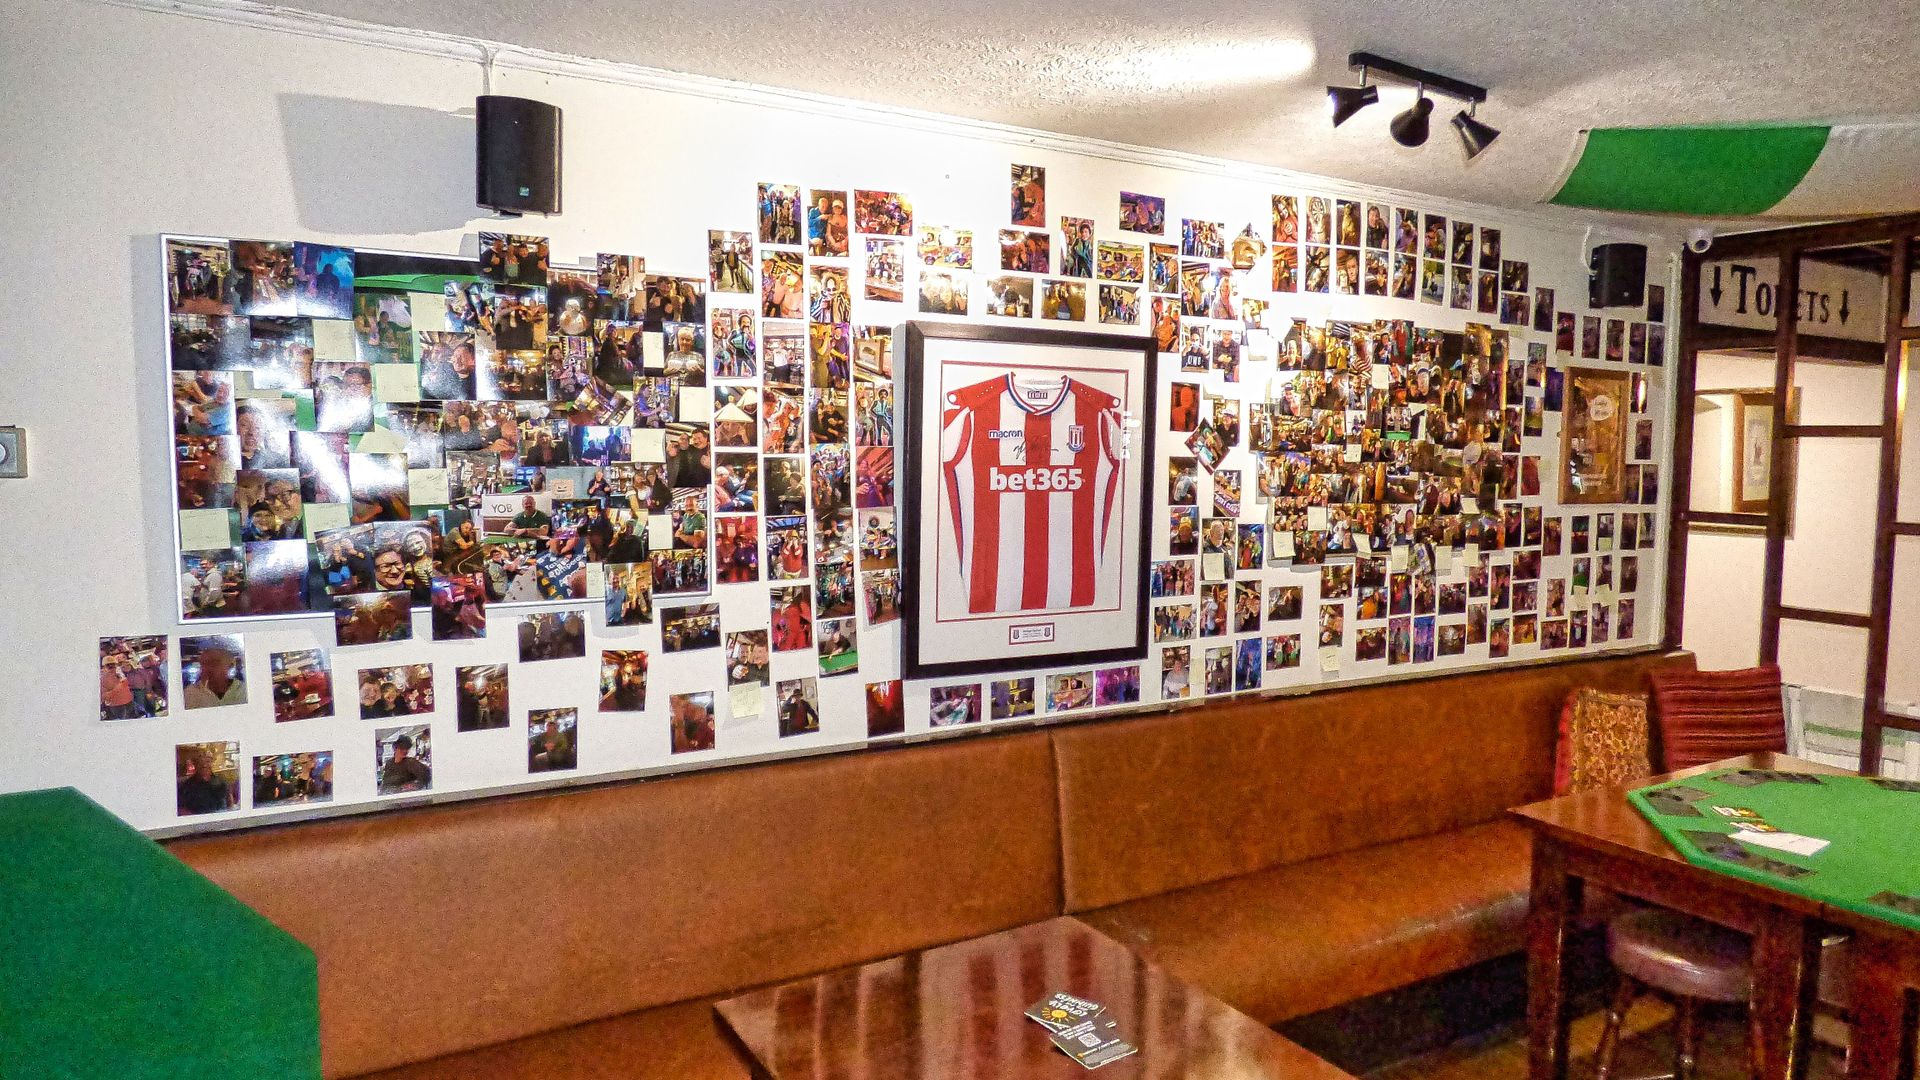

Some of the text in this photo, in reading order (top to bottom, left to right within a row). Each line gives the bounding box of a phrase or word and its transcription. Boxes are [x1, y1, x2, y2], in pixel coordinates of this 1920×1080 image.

[1730, 264, 1830, 324] TOETS
[989, 430, 1023, 438] macron
[990, 467, 1083, 491] bet365
[491, 503, 513, 514] YOB
